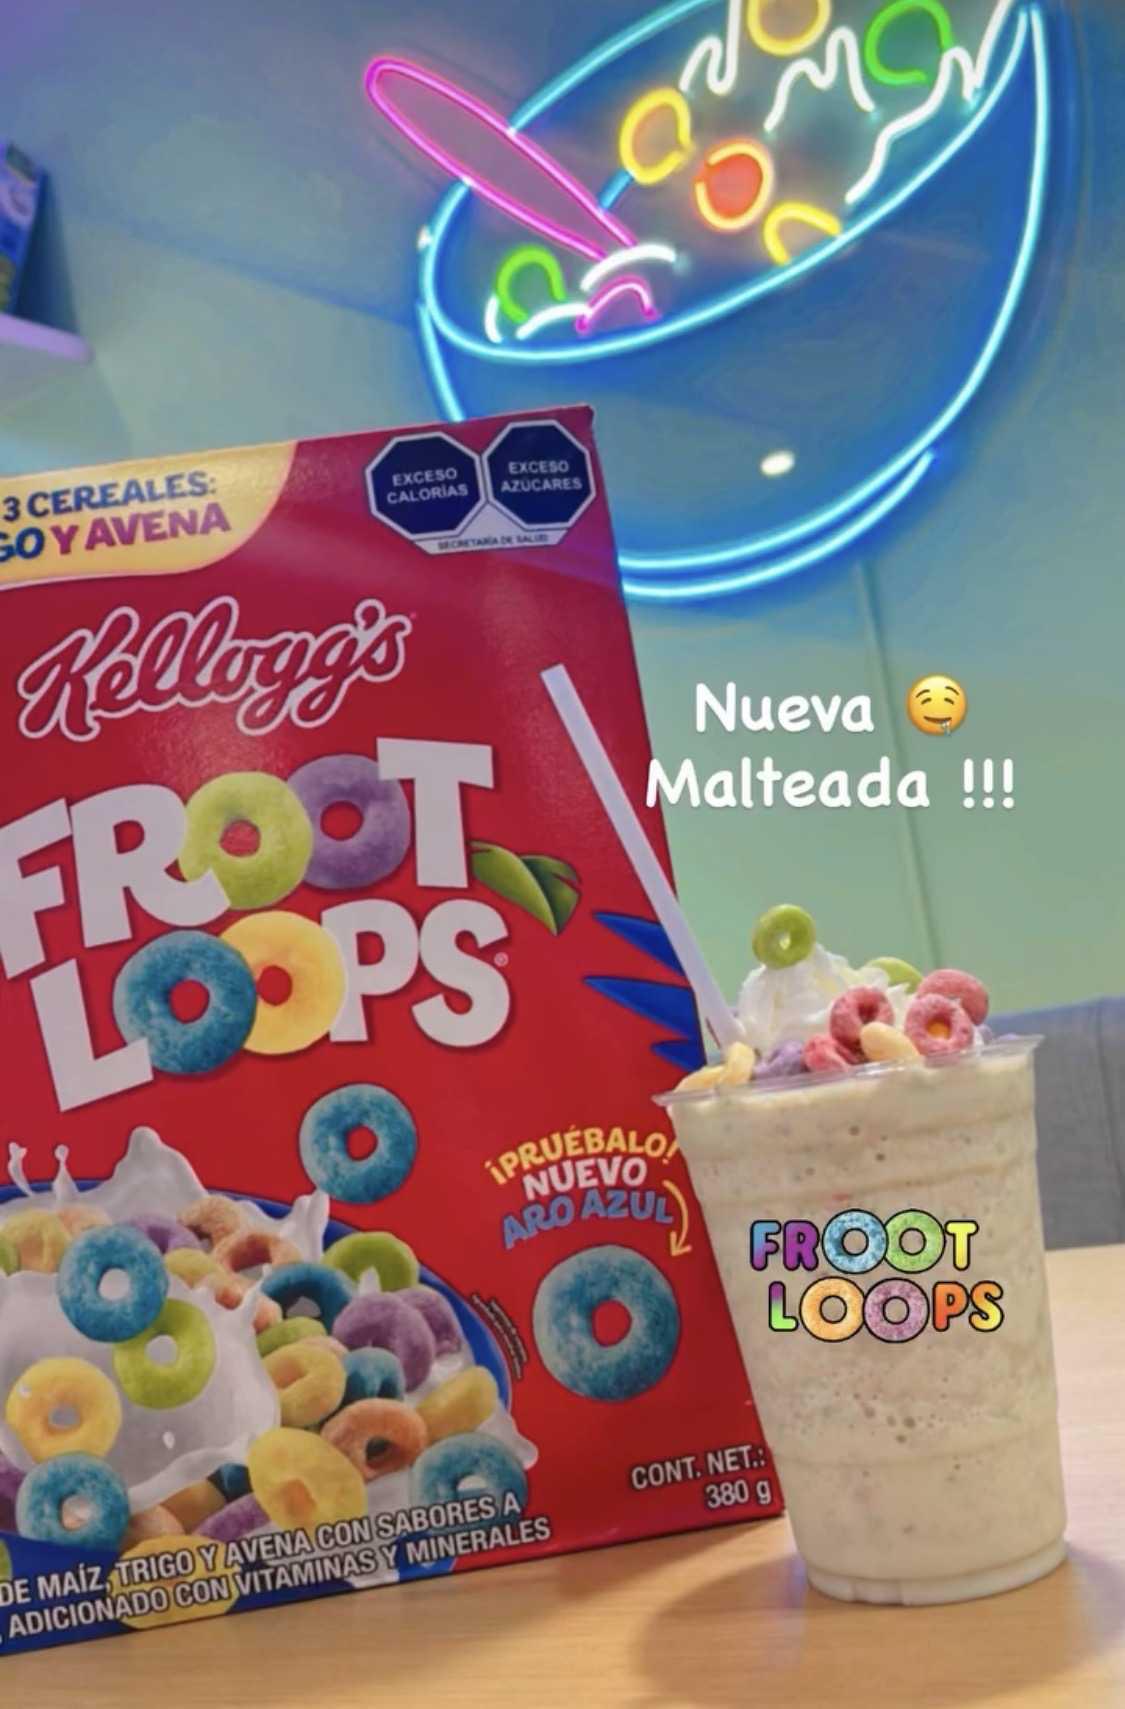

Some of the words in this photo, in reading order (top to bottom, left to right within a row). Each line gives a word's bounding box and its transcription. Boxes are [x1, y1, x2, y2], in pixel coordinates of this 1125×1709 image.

[387, 483, 469, 504] CALORÍAS
[392, 467, 457, 487] EXCESO
[501, 477, 583, 493] AZÚCARES
[508, 460, 569, 475] EXCESO
[3, 496, 21, 522] 3
[26, 470, 217, 518] CEREALES:
[50, 524, 79, 555] Y
[85, 502, 231, 551] AVENA
[17, 596, 413, 742] Kellogg's
[0, 738, 495, 980] FROOT
[30, 898, 511, 1113] LOOPS
[522, 1155, 648, 1201] NUEVO
[502, 1195, 576, 1250] ARO
[580, 1188, 674, 1224] AZUL
[631, 1456, 702, 1490] CONT.
[707, 1444, 766, 1475] NET.:
[705, 1479, 750, 1509] 380
[755, 1480, 772, 1504] g
[0, 1578, 31, 1607] DE
[37, 1563, 112, 1601] MAÍZ,
[115, 1549, 194, 1586] TRIGO
[200, 1544, 218, 1571] Y
[225, 1531, 311, 1567] AVENA
[317, 1520, 371, 1547] CON
[378, 1496, 496, 1538] SABORES
[503, 1491, 521, 1515] A
[8, 1589, 169, 1638] ADICIONADO
[175, 1574, 230, 1607] CON
[234, 1549, 377, 1596] VITAMINAS
[382, 1545, 398, 1569] Y
[406, 1518, 551, 1565] MINERALES
